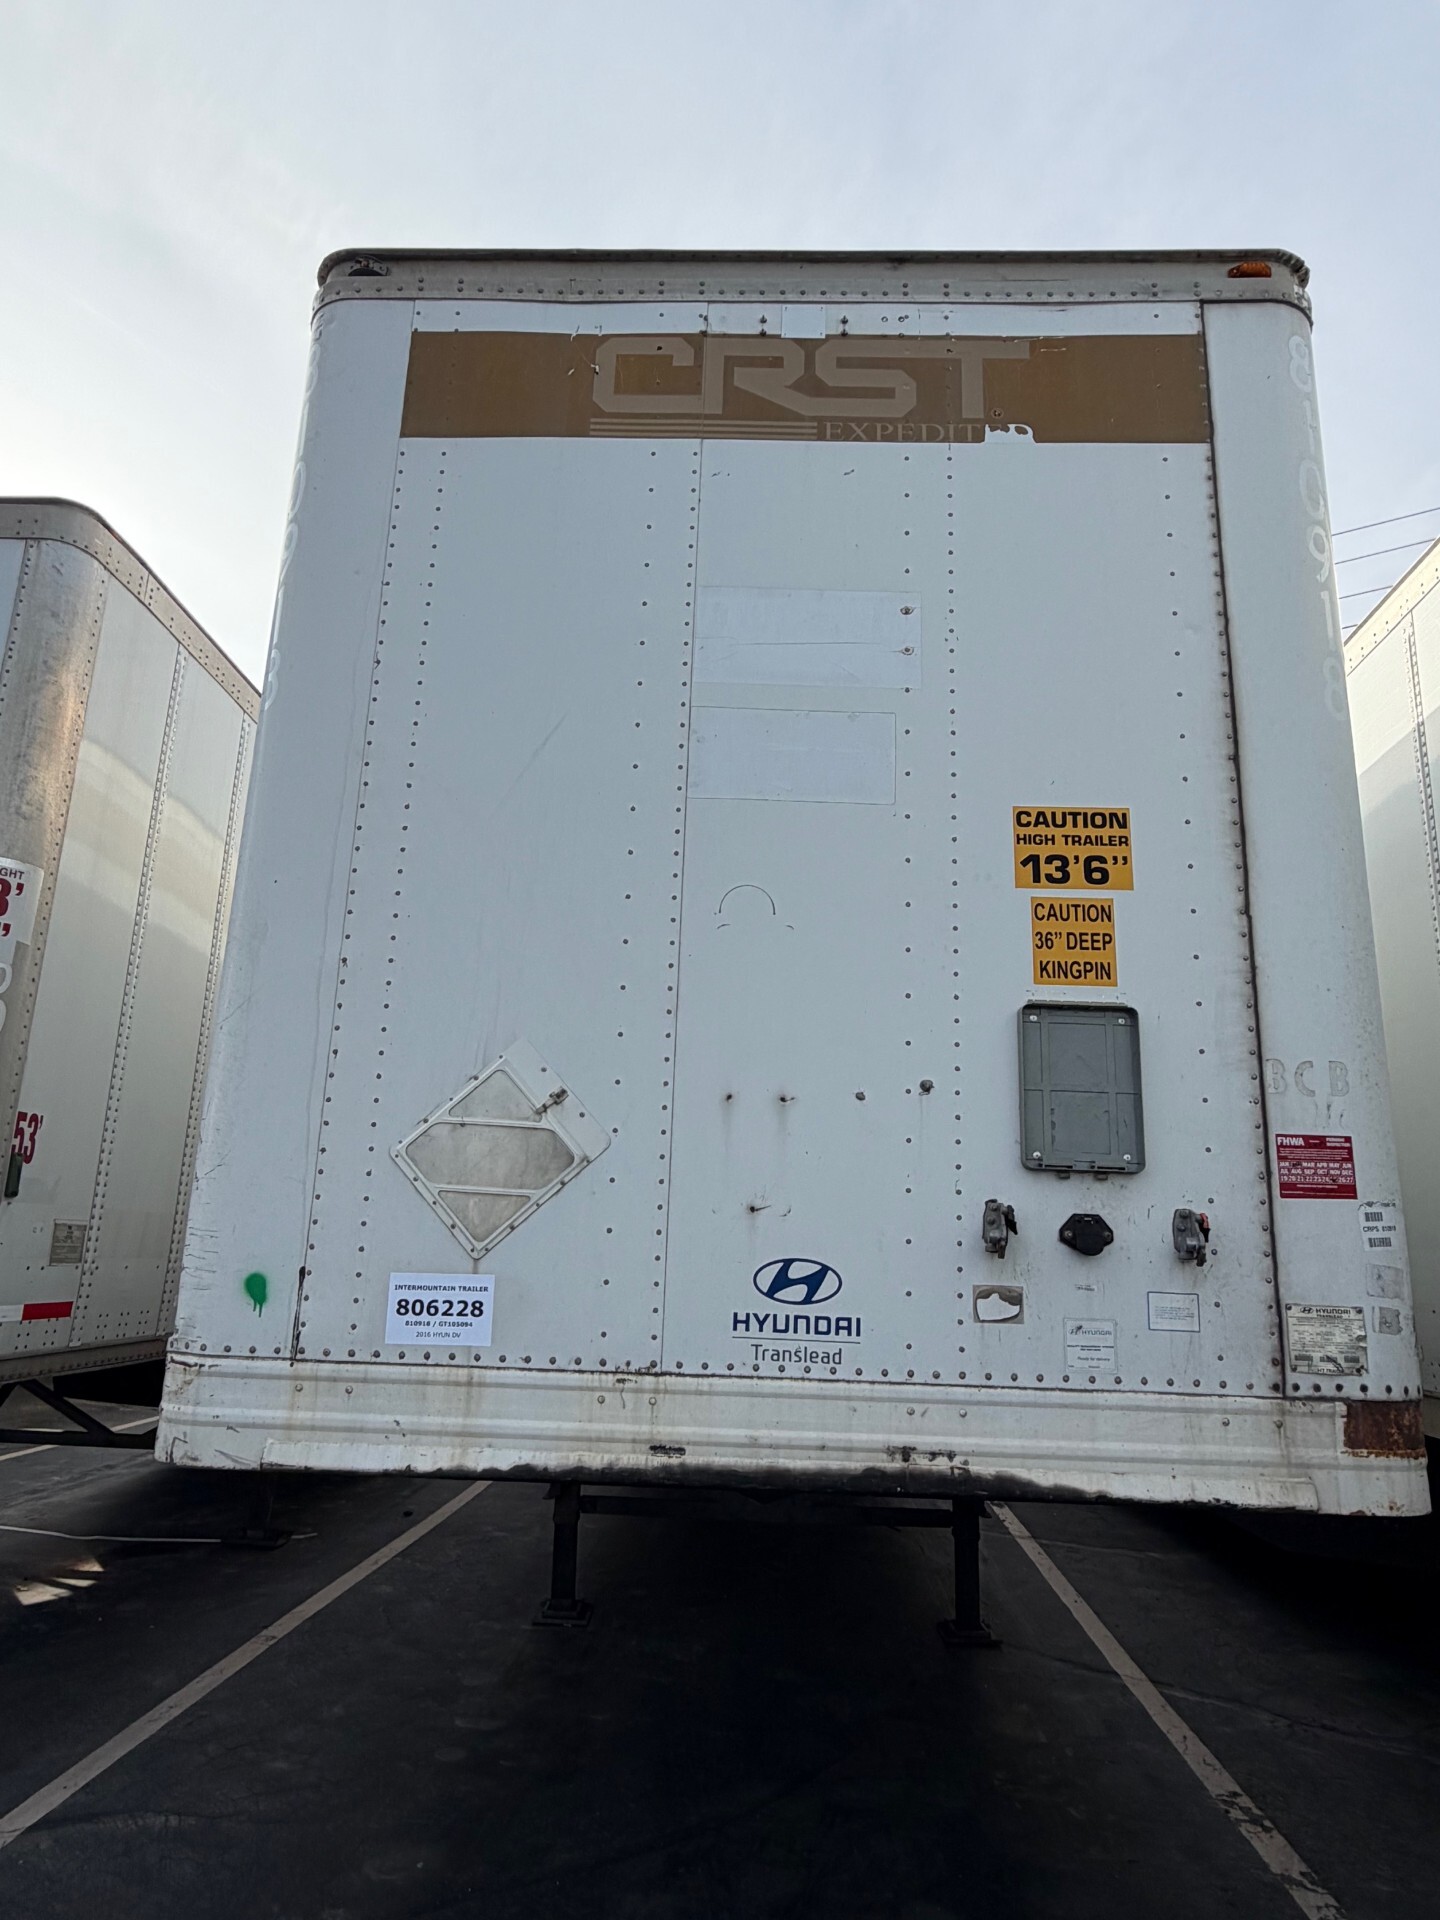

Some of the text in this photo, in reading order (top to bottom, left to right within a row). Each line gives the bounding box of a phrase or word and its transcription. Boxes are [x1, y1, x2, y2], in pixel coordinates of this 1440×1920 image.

[592, 336, 1030, 418] CRST
[1015, 810, 1128, 830] CAUTION
[1016, 833, 1129, 847] HIGH TRAILER
[1033, 902, 1112, 923] CAUTION
[1034, 930, 1113, 951] 36" DEEP
[1039, 960, 1112, 981] KINGPIN
[1277, 1136, 1305, 1146] FHWA
[396, 1298, 484, 1318] 806228
[732, 1311, 861, 1337] HYUNDAI
[750, 1343, 842, 1365] Translead
